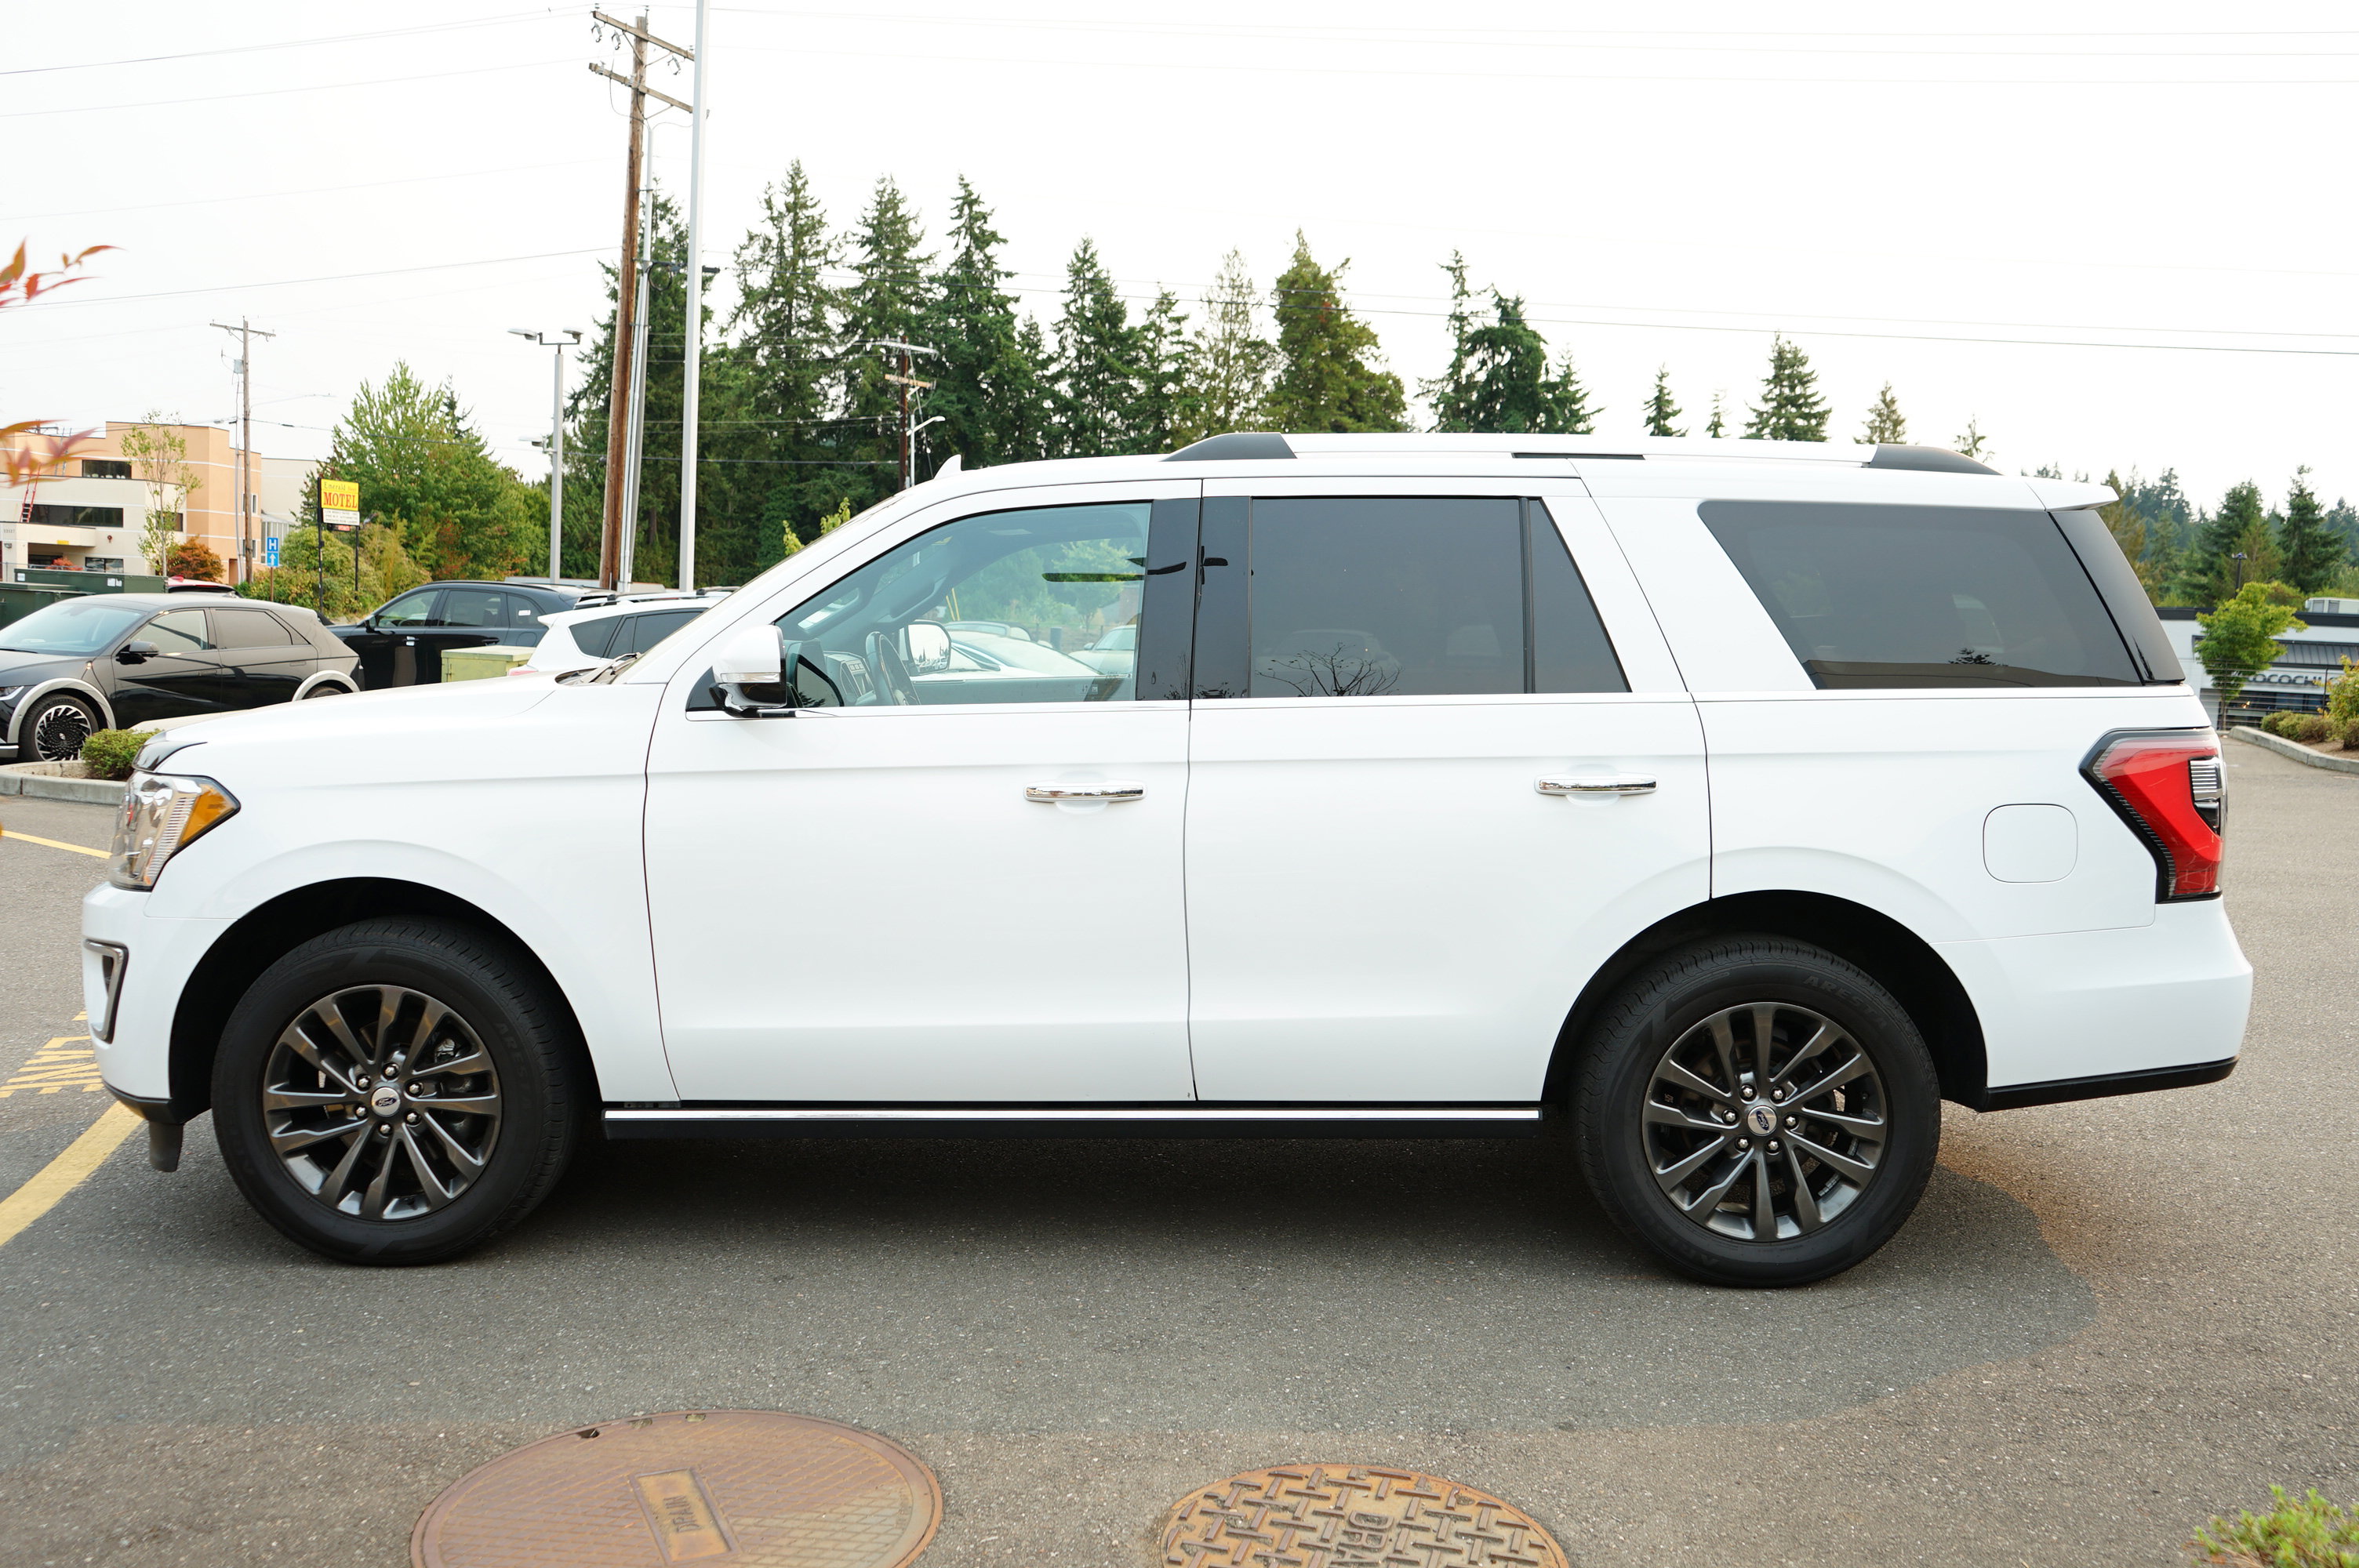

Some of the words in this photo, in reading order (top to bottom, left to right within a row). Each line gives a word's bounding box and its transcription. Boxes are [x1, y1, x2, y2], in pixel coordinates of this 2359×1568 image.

[323, 492, 358, 508] MOTEL
[268, 539, 277, 550] H
[376, 1098, 397, 1107] Ford
[1757, 1112, 1769, 1129] Ford
[662, 1495, 703, 1533] DRAIN
[1329, 1510, 1394, 1568] DRA
